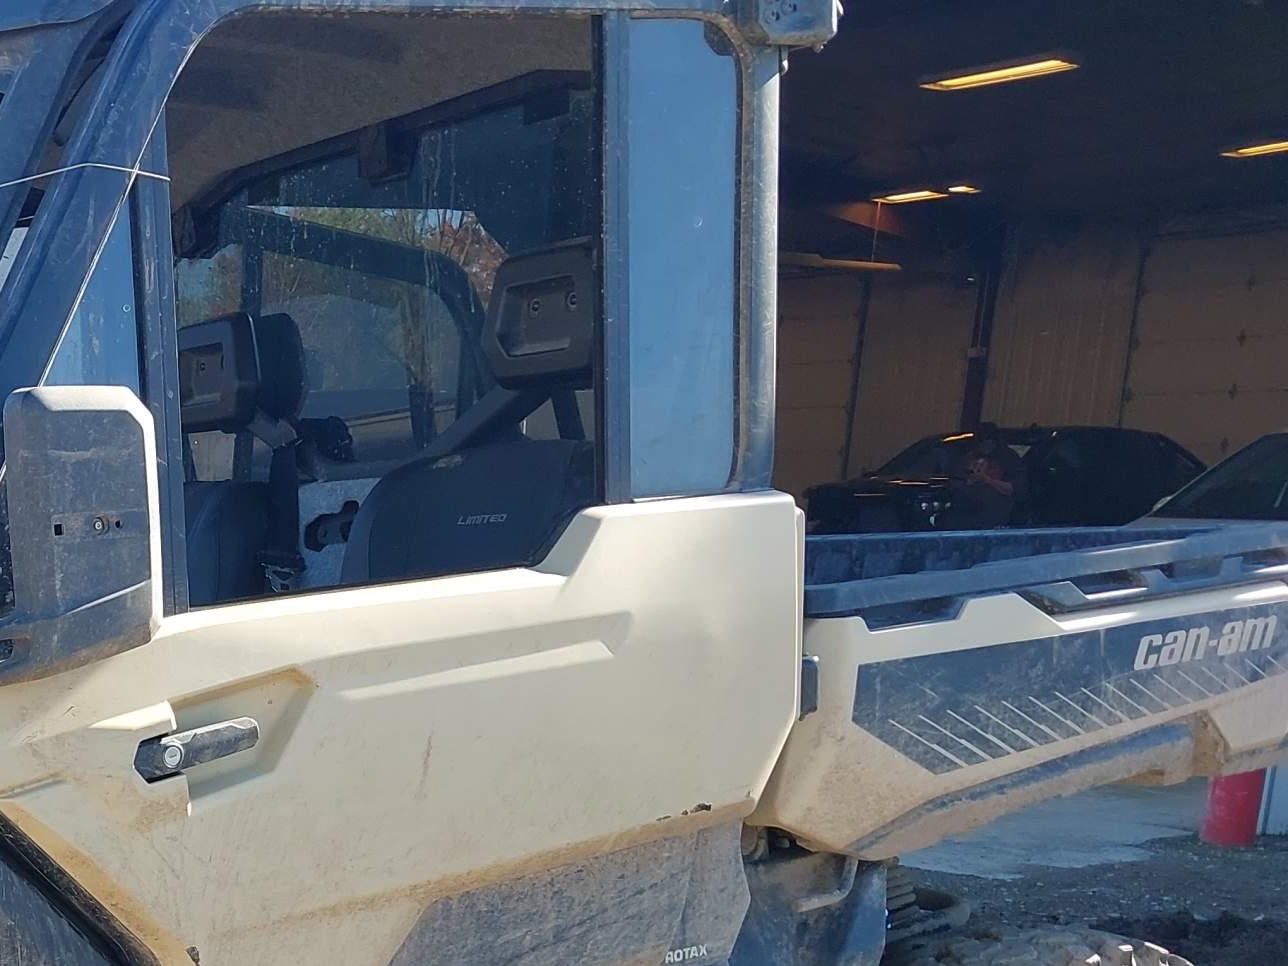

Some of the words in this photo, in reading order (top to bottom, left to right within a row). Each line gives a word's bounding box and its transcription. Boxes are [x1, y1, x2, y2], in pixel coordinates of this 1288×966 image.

[456, 513, 508, 526] LIMITED
[1133, 614, 1278, 671] can-am
[664, 943, 708, 964] ROTAX
